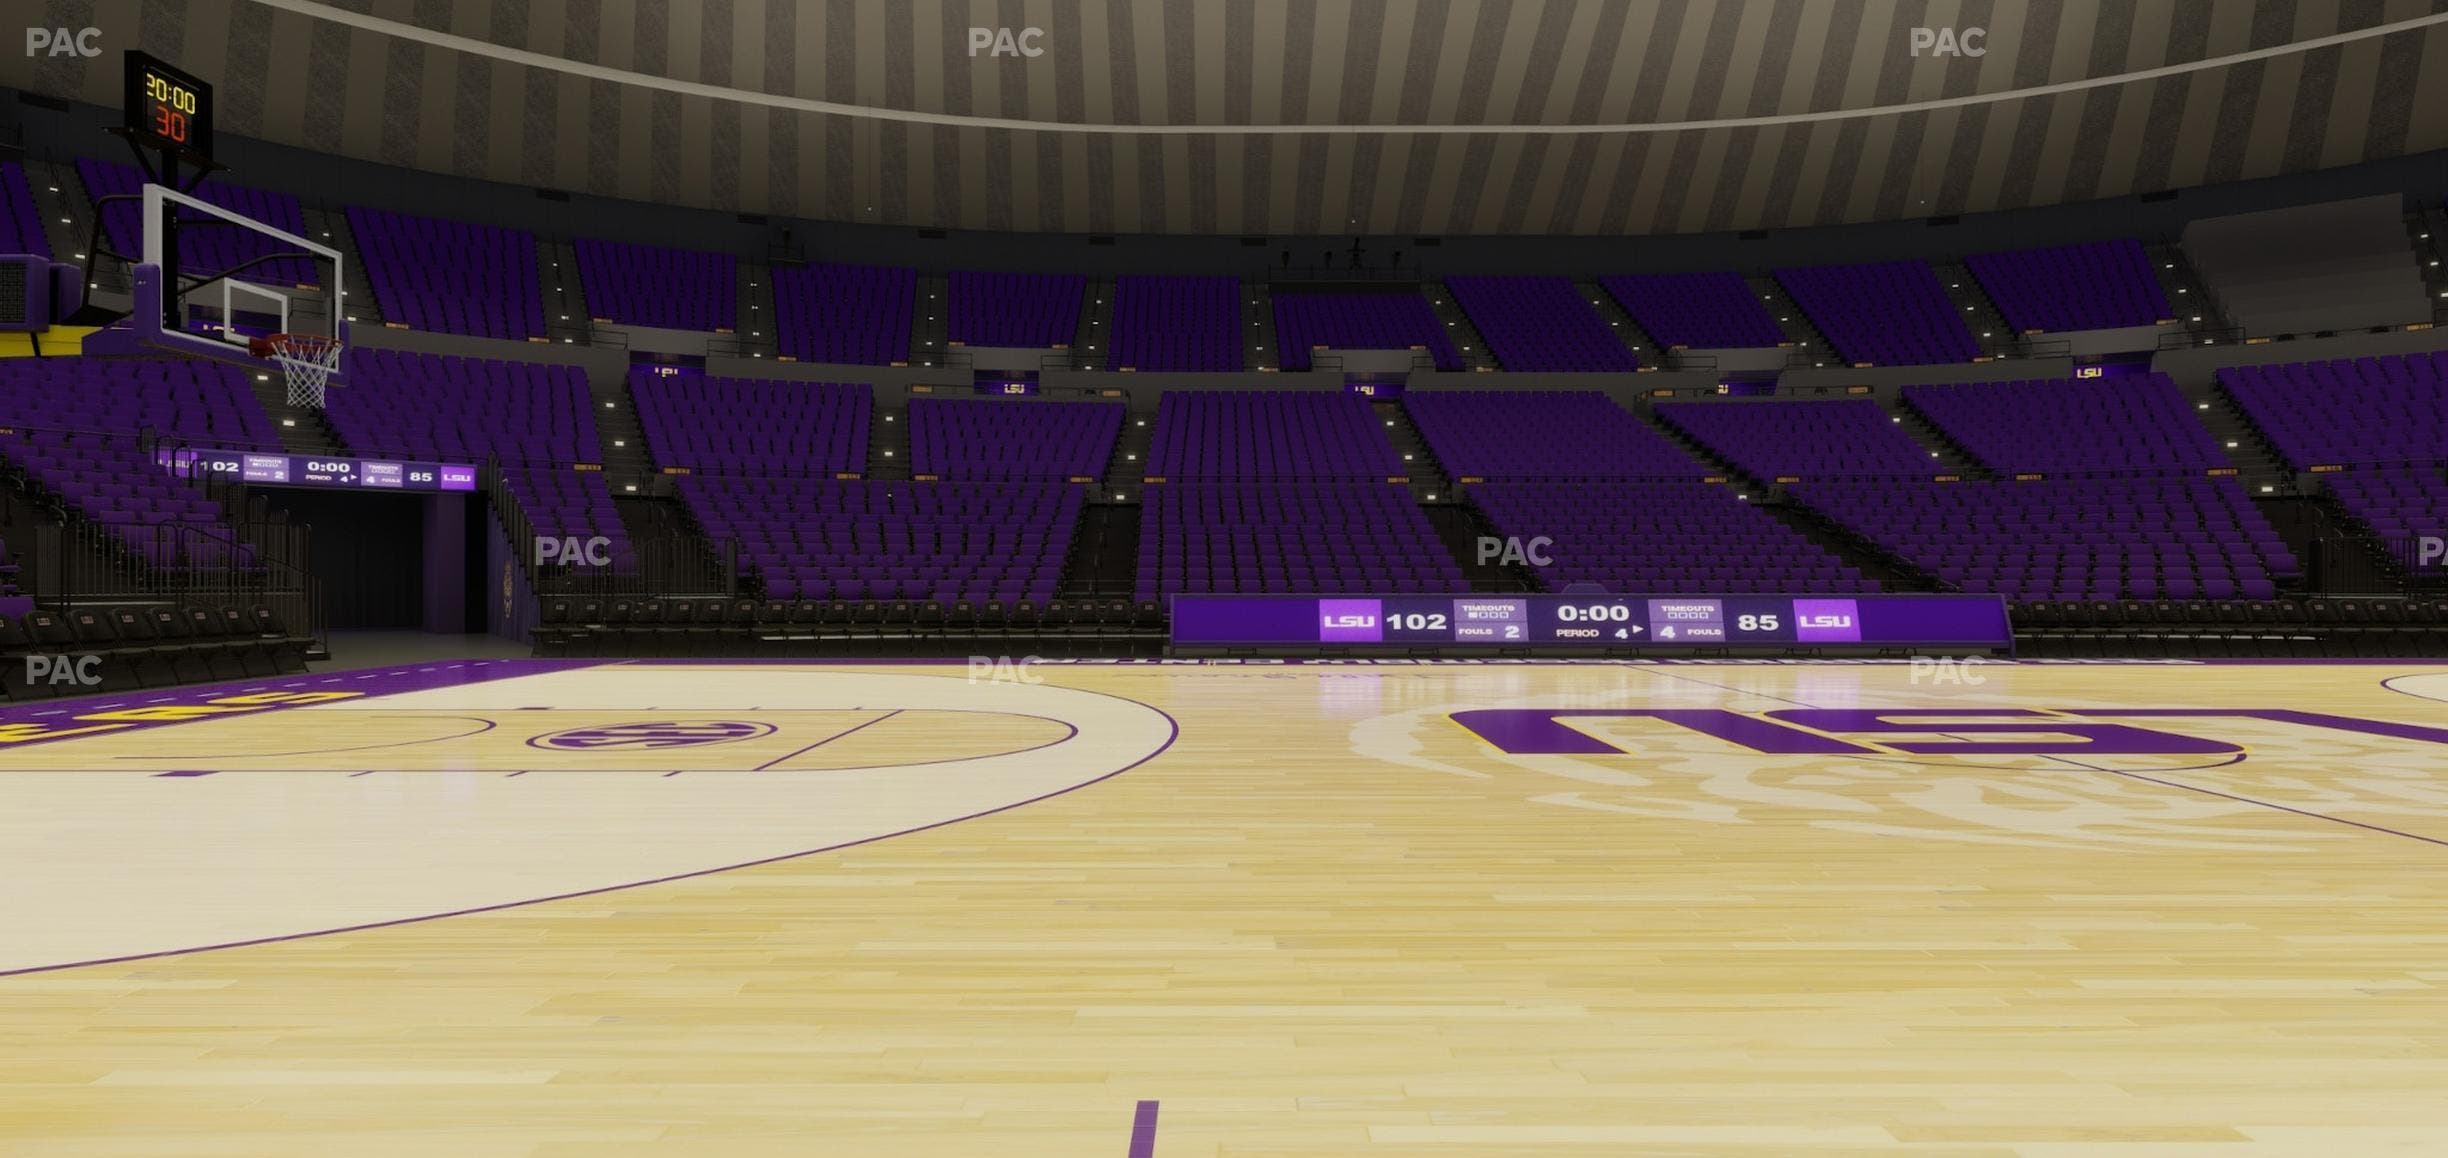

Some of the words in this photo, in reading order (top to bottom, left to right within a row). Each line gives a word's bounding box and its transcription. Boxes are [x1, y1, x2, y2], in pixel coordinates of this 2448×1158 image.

[155, 105, 185, 143] 30
[2076, 367, 2102, 379] LSU
[1004, 383, 1025, 394] LSU
[307, 461, 350, 473] 0:00
[274, 471, 285, 480] 2
[306, 474, 332, 482] PERIOD
[340, 475, 349, 483] 4
[409, 472, 433, 482] 85
[443, 474, 471, 482] LSU
[1463, 604, 1515, 612] TIMEOUTS
[1557, 604, 1630, 622] 0:00
[1661, 604, 1715, 612] TIMEOUTS
[1324, 615, 1375, 628] LSU
[1386, 613, 1447, 630] 102
[1738, 614, 1779, 631] 85
[1800, 615, 1851, 628] LSU
[1458, 628, 1493, 636] FOULS
[1505, 625, 1520, 639] 2
[1556, 628, 1599, 638] PERIOD
[1614, 628, 1629, 639] 4
[1659, 625, 1676, 639] 4
[1687, 628, 1722, 636] FOULS
